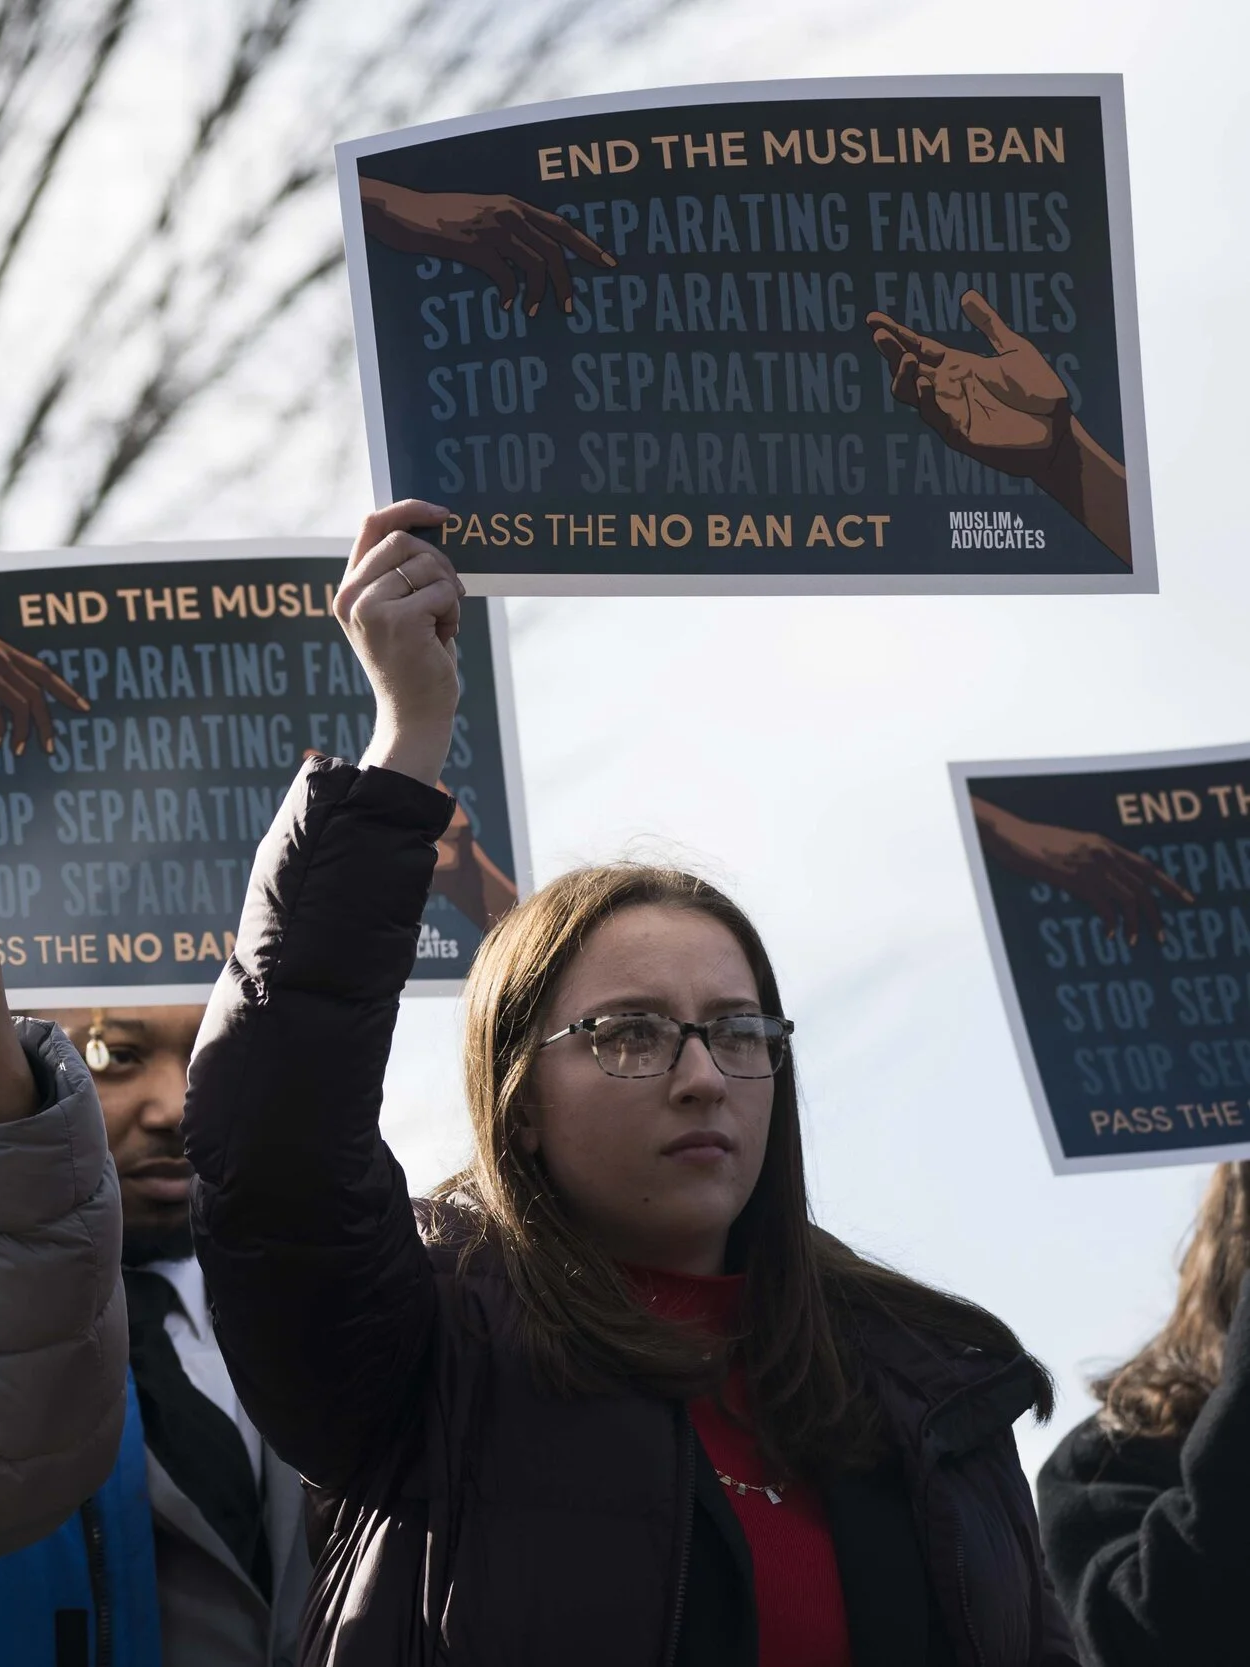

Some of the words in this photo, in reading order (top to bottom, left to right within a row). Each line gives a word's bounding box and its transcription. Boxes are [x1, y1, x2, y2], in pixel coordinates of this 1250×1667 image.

[538, 140, 640, 181] END
[651, 131, 748, 169] THE
[763, 127, 950, 165] MUSLIM
[966, 127, 1066, 164] BAN
[868, 191, 1072, 253] FAMILIES
[566, 271, 854, 334] SEPARATING
[875, 271, 1077, 333] FAMIES
[428, 356, 548, 421] STOP
[571, 351, 861, 413] SEPARATING
[435, 432, 556, 494] STOP
[578, 432, 867, 495] SEPARATING
[441, 513, 534, 546] PASS
[545, 513, 616, 546] THE
[630, 513, 693, 547] NO
[707, 513, 792, 547] BAN
[806, 514, 891, 548] ACT
[949, 511, 1011, 529] MUSLIM
[951, 529, 1046, 549] ADVOCATES
[19, 591, 109, 627] END
[116, 587, 201, 622] THE
[212, 583, 336, 618] MUSLI
[48, 713, 295, 773] SEPARATING
[1116, 789, 1203, 826] END
[1207, 784, 1250, 818] TH
[61, 858, 251, 918] SEPARAT
[34, 934, 98, 964] THE
[107, 932, 162, 963] NO
[417, 940, 459, 959] CATES
[1056, 978, 1154, 1033] STOP
[1073, 1043, 1173, 1096] STOP
[1090, 1105, 1174, 1136] PASS
[1176, 1100, 1244, 1129] THE
